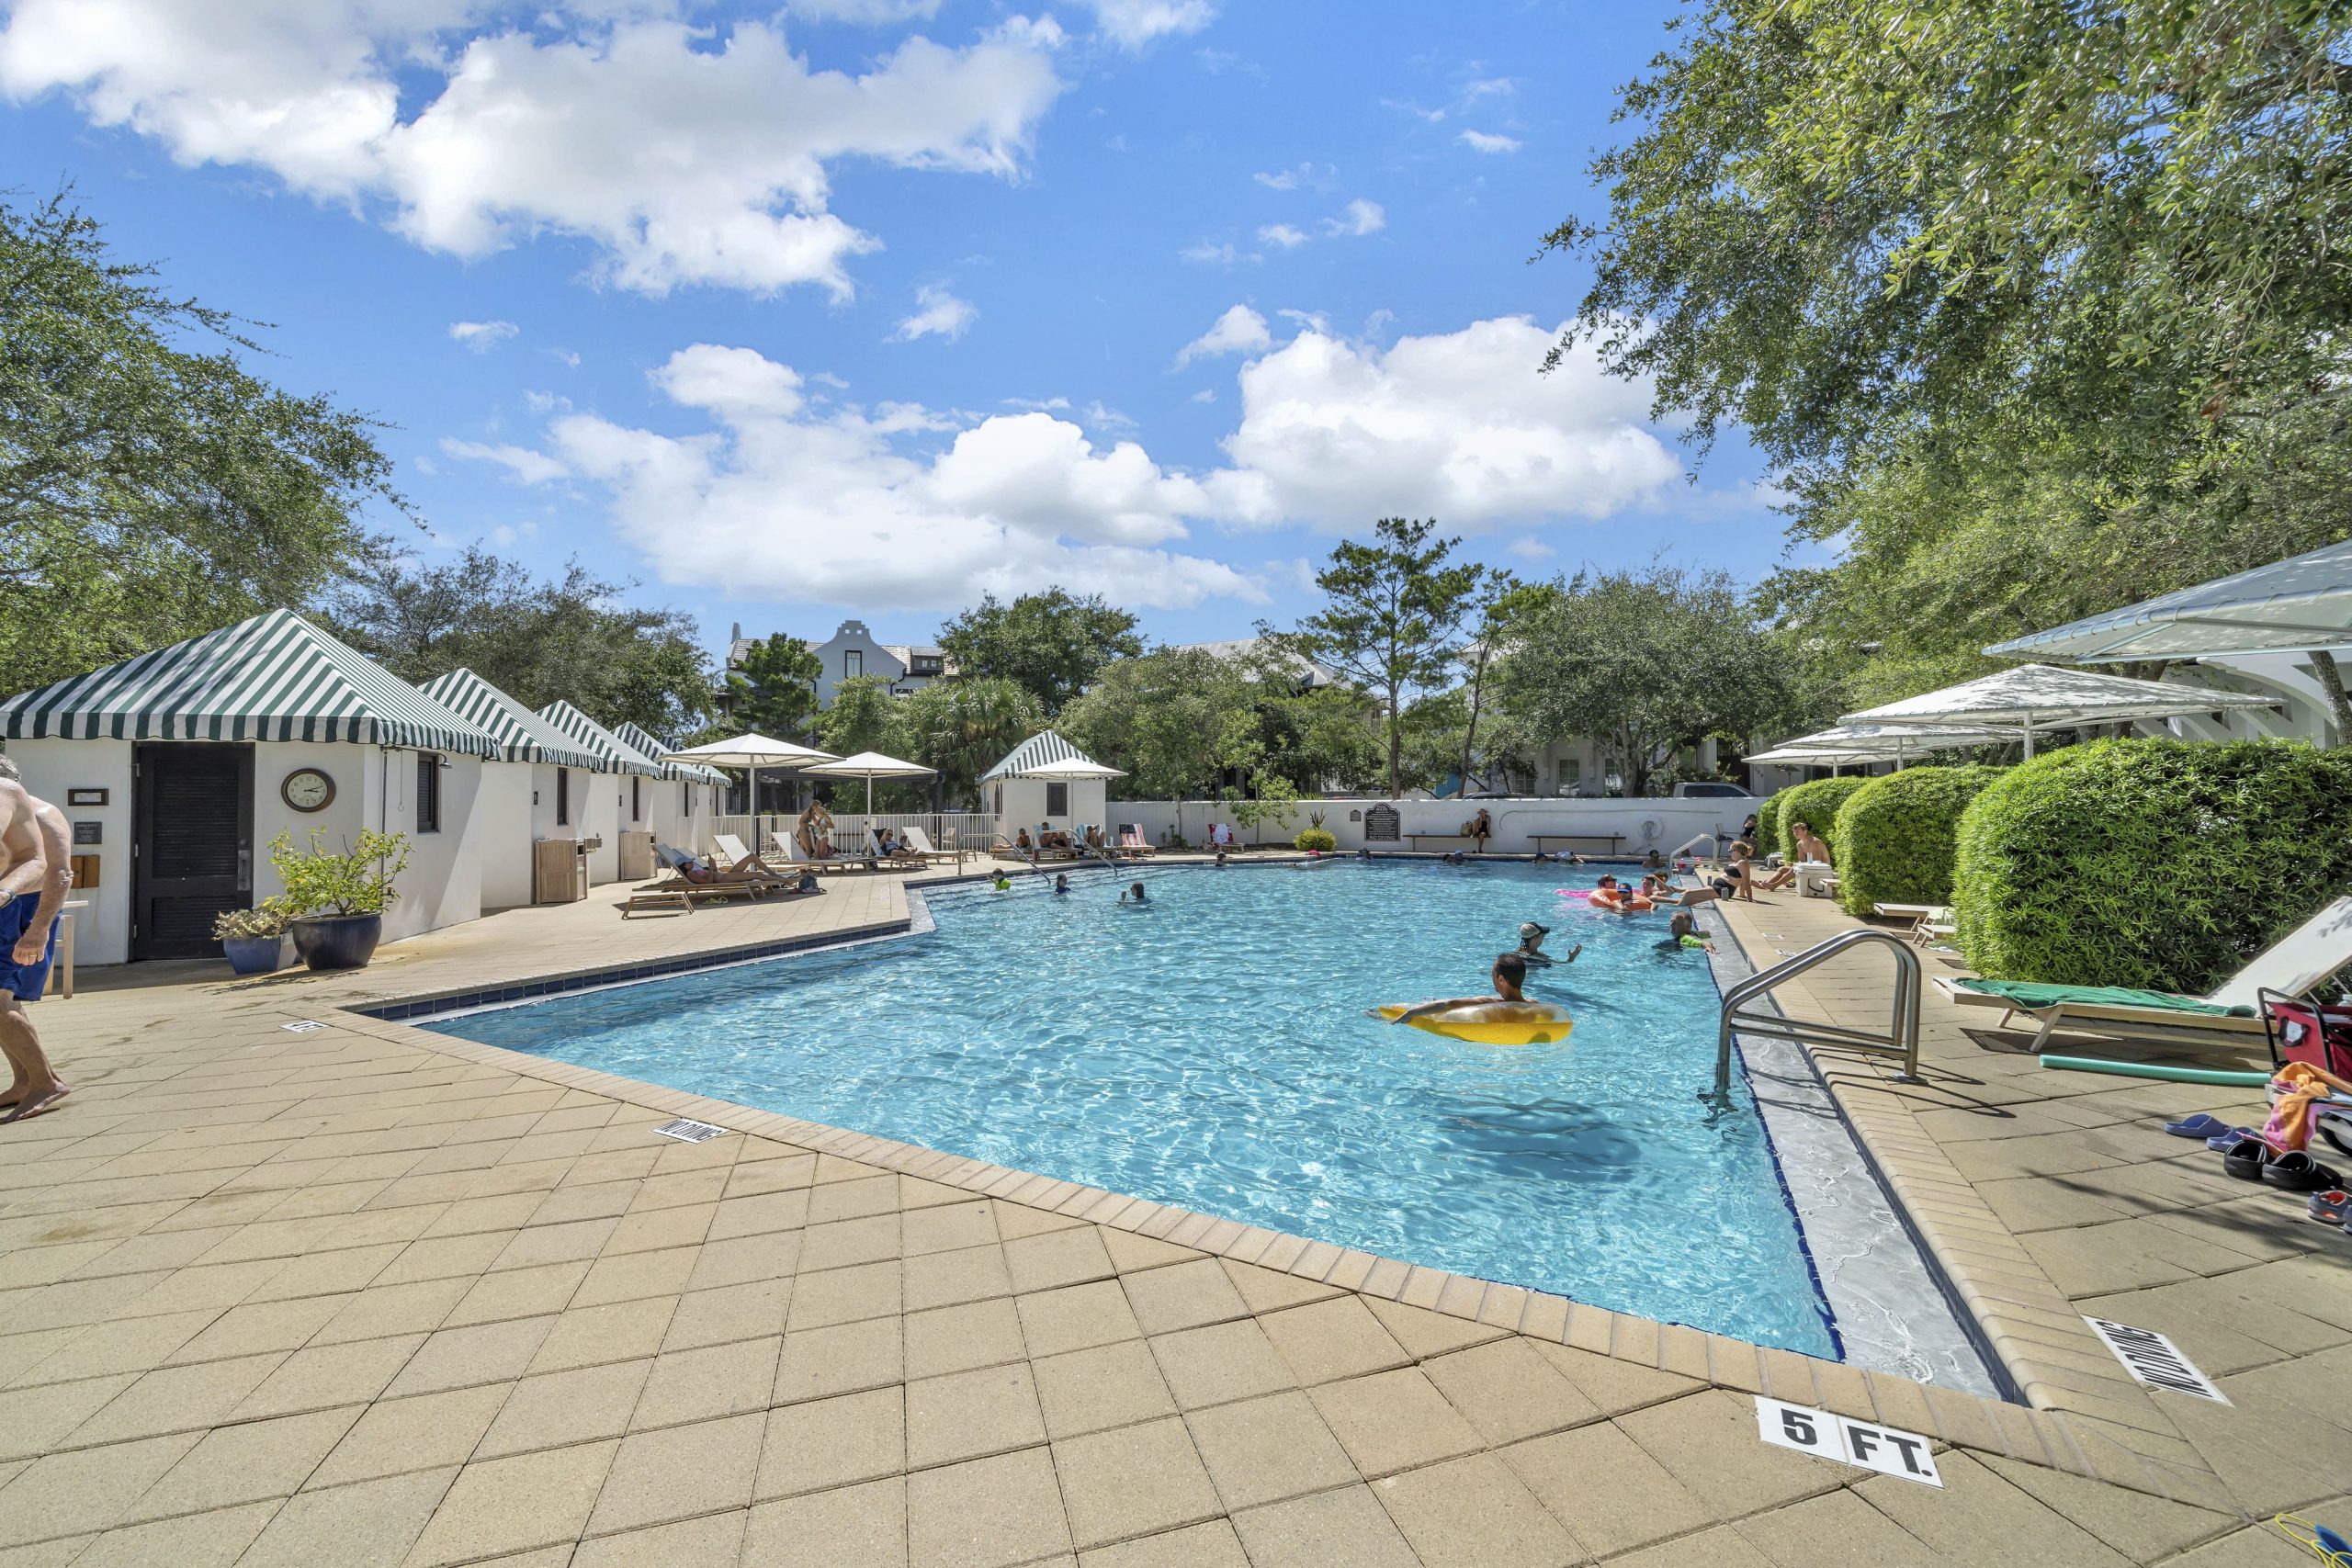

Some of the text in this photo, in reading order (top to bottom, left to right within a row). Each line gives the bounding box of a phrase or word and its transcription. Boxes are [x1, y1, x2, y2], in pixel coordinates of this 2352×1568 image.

[657, 1120, 723, 1141] NO DIVING
[2095, 1321, 2213, 1398] NO DIVING
[1781, 1408, 1933, 1477] 5 FT.
